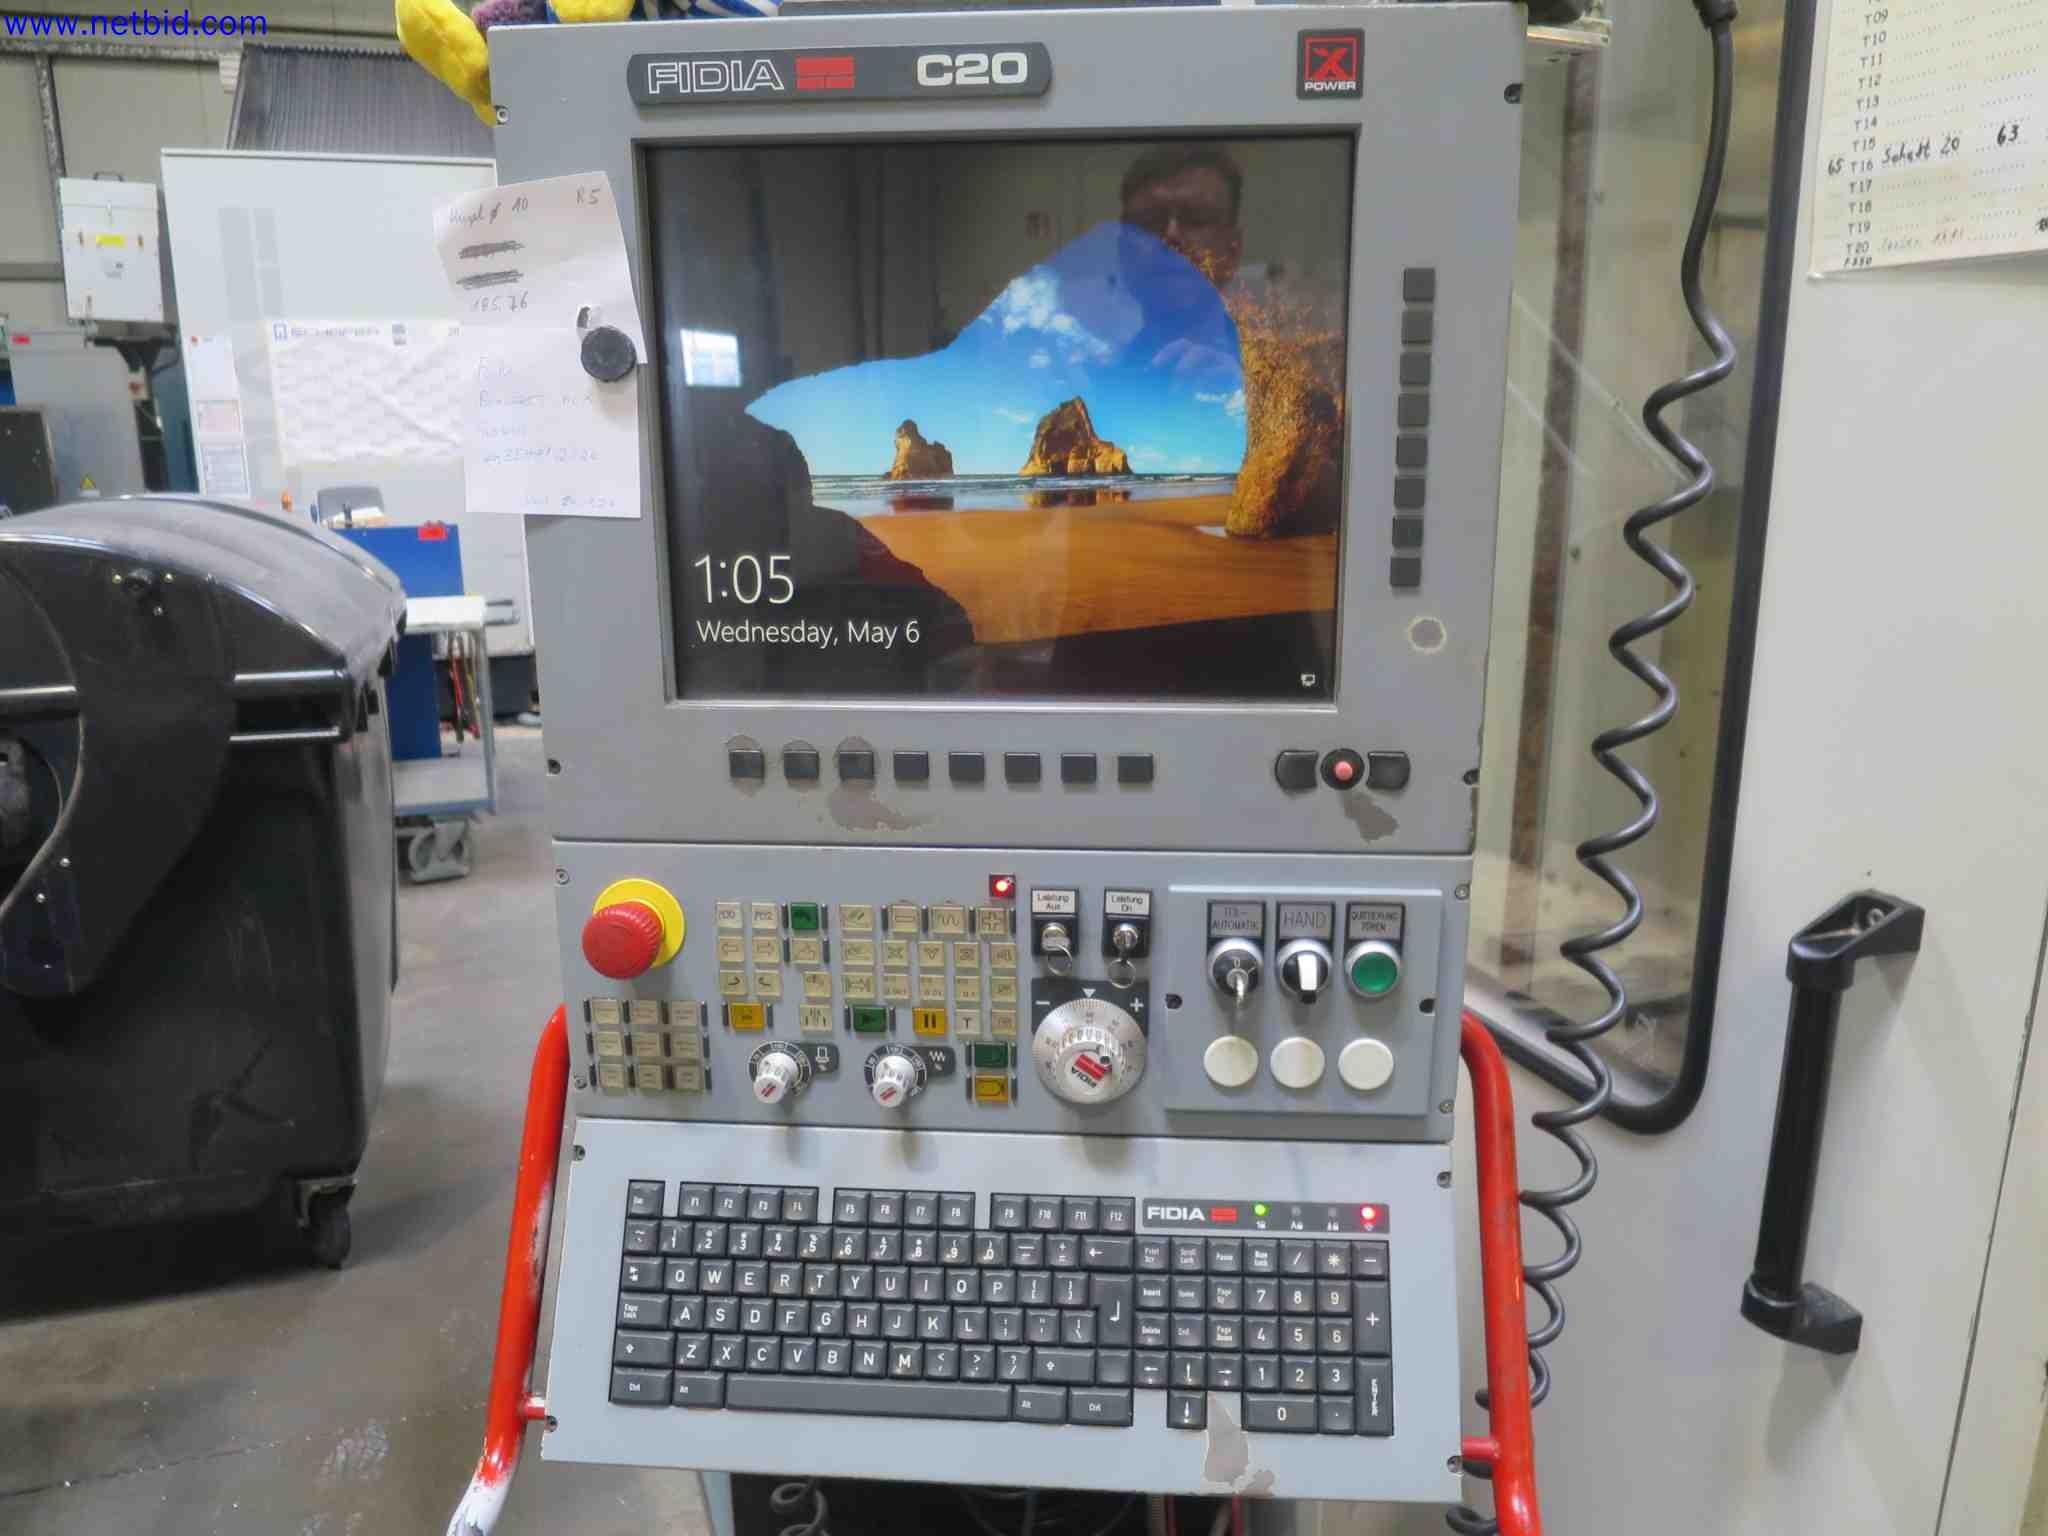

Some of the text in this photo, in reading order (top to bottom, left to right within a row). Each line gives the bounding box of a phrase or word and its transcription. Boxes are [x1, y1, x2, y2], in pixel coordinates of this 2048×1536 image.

[1863, 31, 1888, 48] T10
[1860, 53, 1884, 69] T11
[646, 52, 1029, 95] FIDIA C20
[1304, 80, 1357, 92] POWER
[1996, 123, 2020, 147] 63
[1940, 136, 1961, 155] 20
[1849, 179, 1872, 194] T17
[1847, 221, 1871, 236] T19
[694, 554, 795, 604] 1:05
[696, 619, 921, 650] Wednesday, May 6
[1282, 911, 1327, 929] HAND
[1109, 1211, 1123, 1222] F12
[1146, 1206, 1206, 1221] FIDIA
[704, 1237, 713, 1249] 2
[738, 1239, 747, 1251] 3
[773, 1239, 782, 1252] 4
[808, 1241, 817, 1253] 5
[843, 1243, 852, 1256] 6
[879, 1243, 888, 1257] 7
[914, 1246, 923, 1258] 8
[949, 1247, 958, 1259] 9
[985, 1248, 995, 1261] 0
[675, 1269, 685, 1283] Q
[707, 1270, 722, 1284] W
[744, 1271, 755, 1286] E
[779, 1273, 790, 1288] R
[814, 1274, 825, 1289] T
[851, 1275, 860, 1290] Y
[885, 1277, 896, 1292] U
[955, 1279, 967, 1294] O
[992, 1281, 1003, 1296] P
[1256, 1289, 1340, 1305] 7 8 9
[679, 1306, 974, 1333] A S D F G H J K L
[1256, 1327, 1342, 1344] 4 5 6
[686, 1343, 912, 1368] Z X C V B N M
[1295, 1368, 1305, 1383] 2
[1332, 1368, 1341, 1383] 3
[1277, 1406, 1287, 1421] 0
